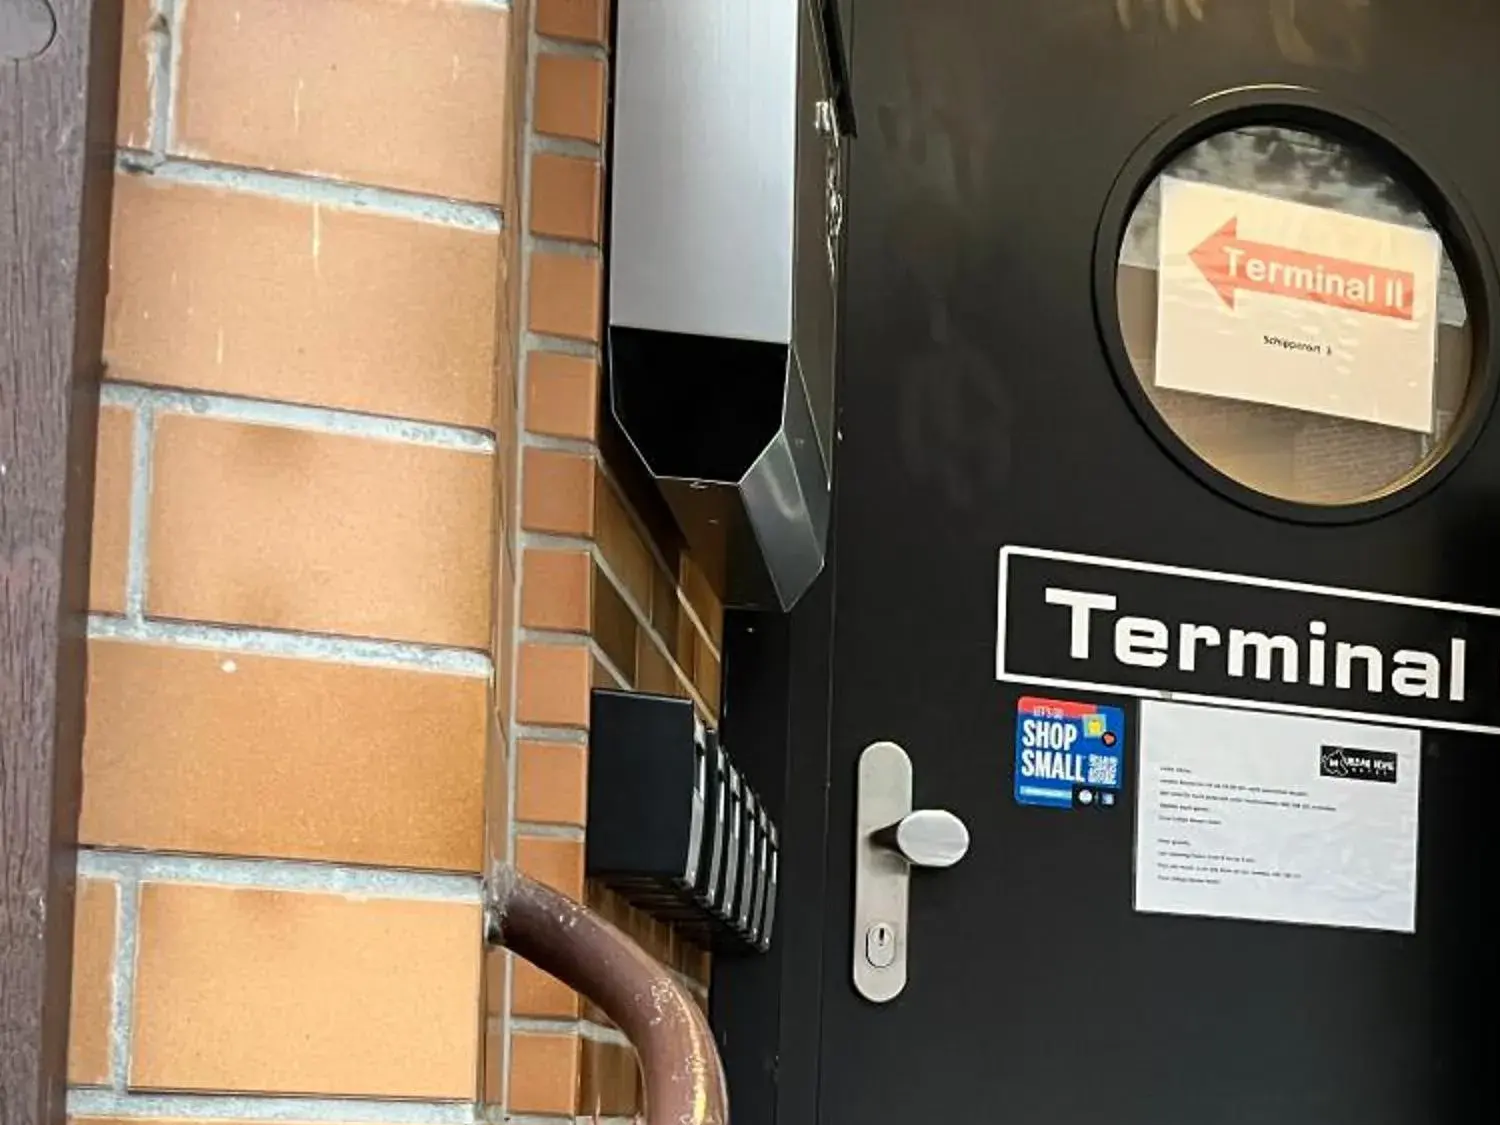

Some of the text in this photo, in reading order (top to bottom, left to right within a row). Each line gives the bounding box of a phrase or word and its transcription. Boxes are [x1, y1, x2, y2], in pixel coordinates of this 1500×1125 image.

[1224, 247, 1403, 308] Terminal II
[1045, 586, 1467, 702] Terminal
[1021, 718, 1077, 751] SHOP
[1021, 748, 1086, 782] SMALL
